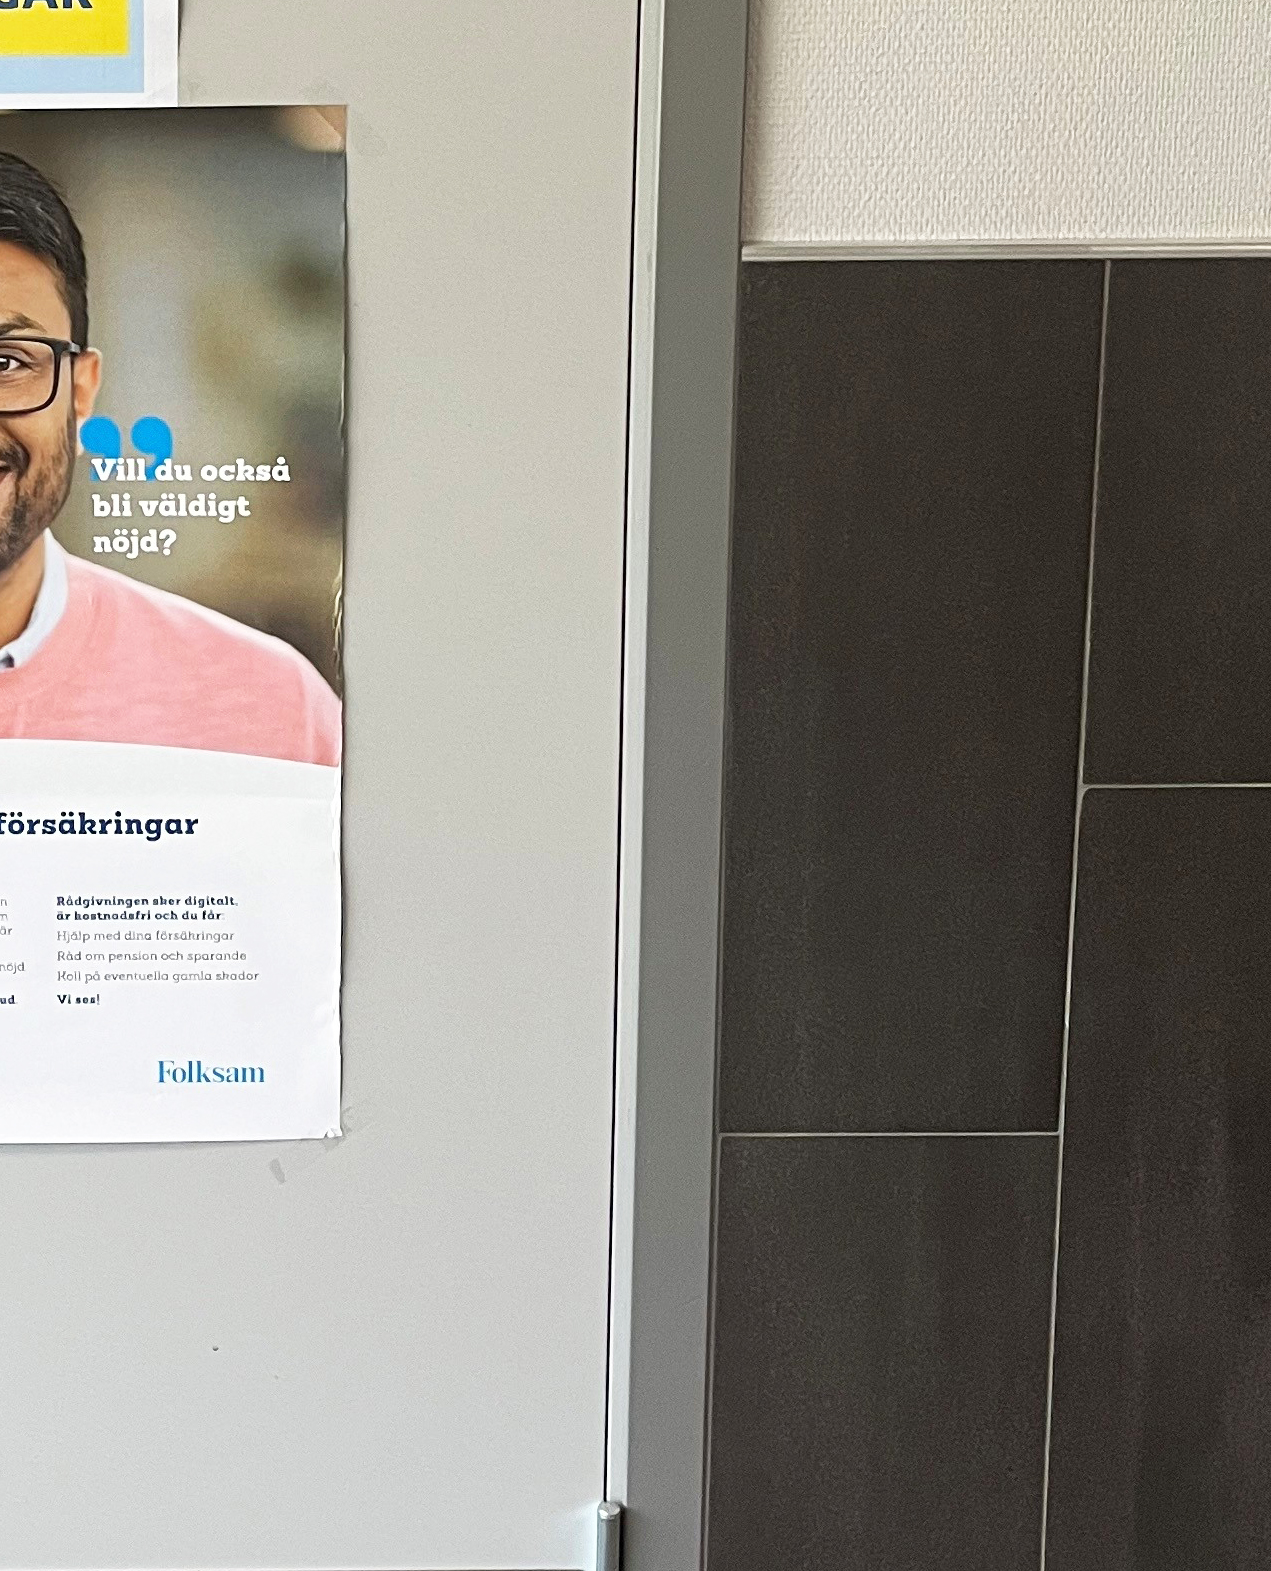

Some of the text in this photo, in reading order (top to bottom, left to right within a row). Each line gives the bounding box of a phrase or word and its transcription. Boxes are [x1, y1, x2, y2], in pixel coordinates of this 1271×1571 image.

[91, 456, 291, 482] Vill du också
[92, 493, 251, 523] bli väldigt
[92, 529, 177, 559] nöjd?
[56, 895, 149, 908] Rådgivningen
[152, 895, 181, 906] sker
[56, 910, 71, 920] är
[74, 910, 151, 920] kostnadsfri
[154, 910, 178, 920] och
[182, 910, 198, 920] du
[57, 930, 235, 943] Hjälp med dina försäkringar
[57, 950, 247, 963] Råd om pension och sparande
[57, 970, 259, 984] Koll på eventuella gamla skador
[56, 994, 71, 1005] Vi
[157, 1059, 266, 1085] Folksam
